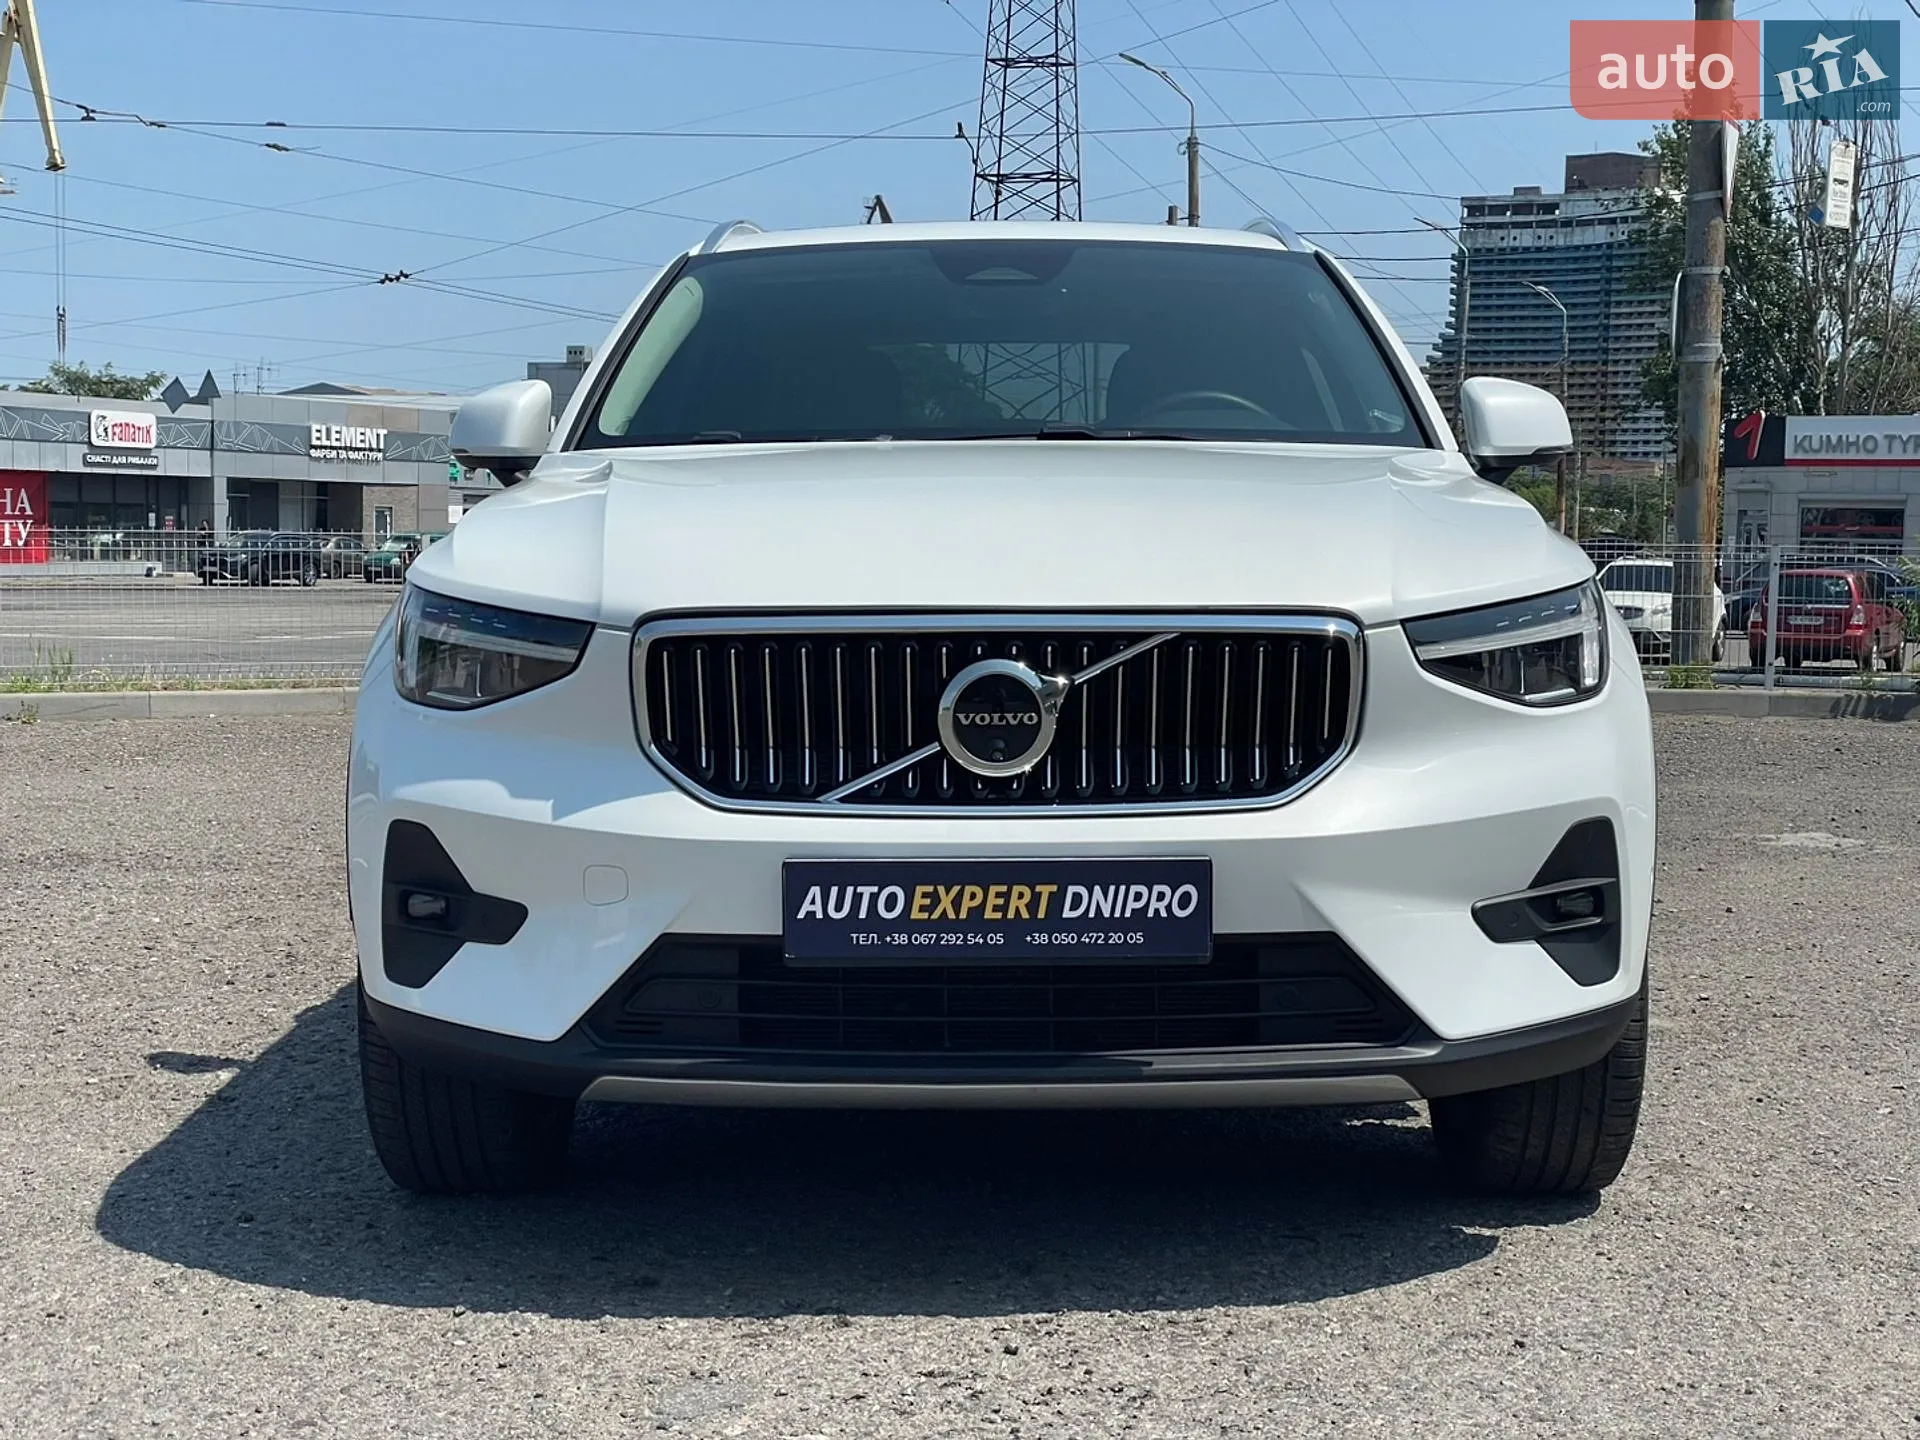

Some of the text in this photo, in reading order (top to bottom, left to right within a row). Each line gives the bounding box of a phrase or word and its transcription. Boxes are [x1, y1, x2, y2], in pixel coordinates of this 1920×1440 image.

[311, 424, 388, 449] ELEMENT
[1793, 434, 1878, 454] KUMHO
[309, 448, 337, 459] ФАРБИ
[956, 713, 1038, 725] VOLVO
[797, 885, 1199, 920] AUTO EXPERT DNIPRO
[850, 932, 1144, 945] ТЕЛ. +38 067 292 54 05 +38 050 472 20 05
